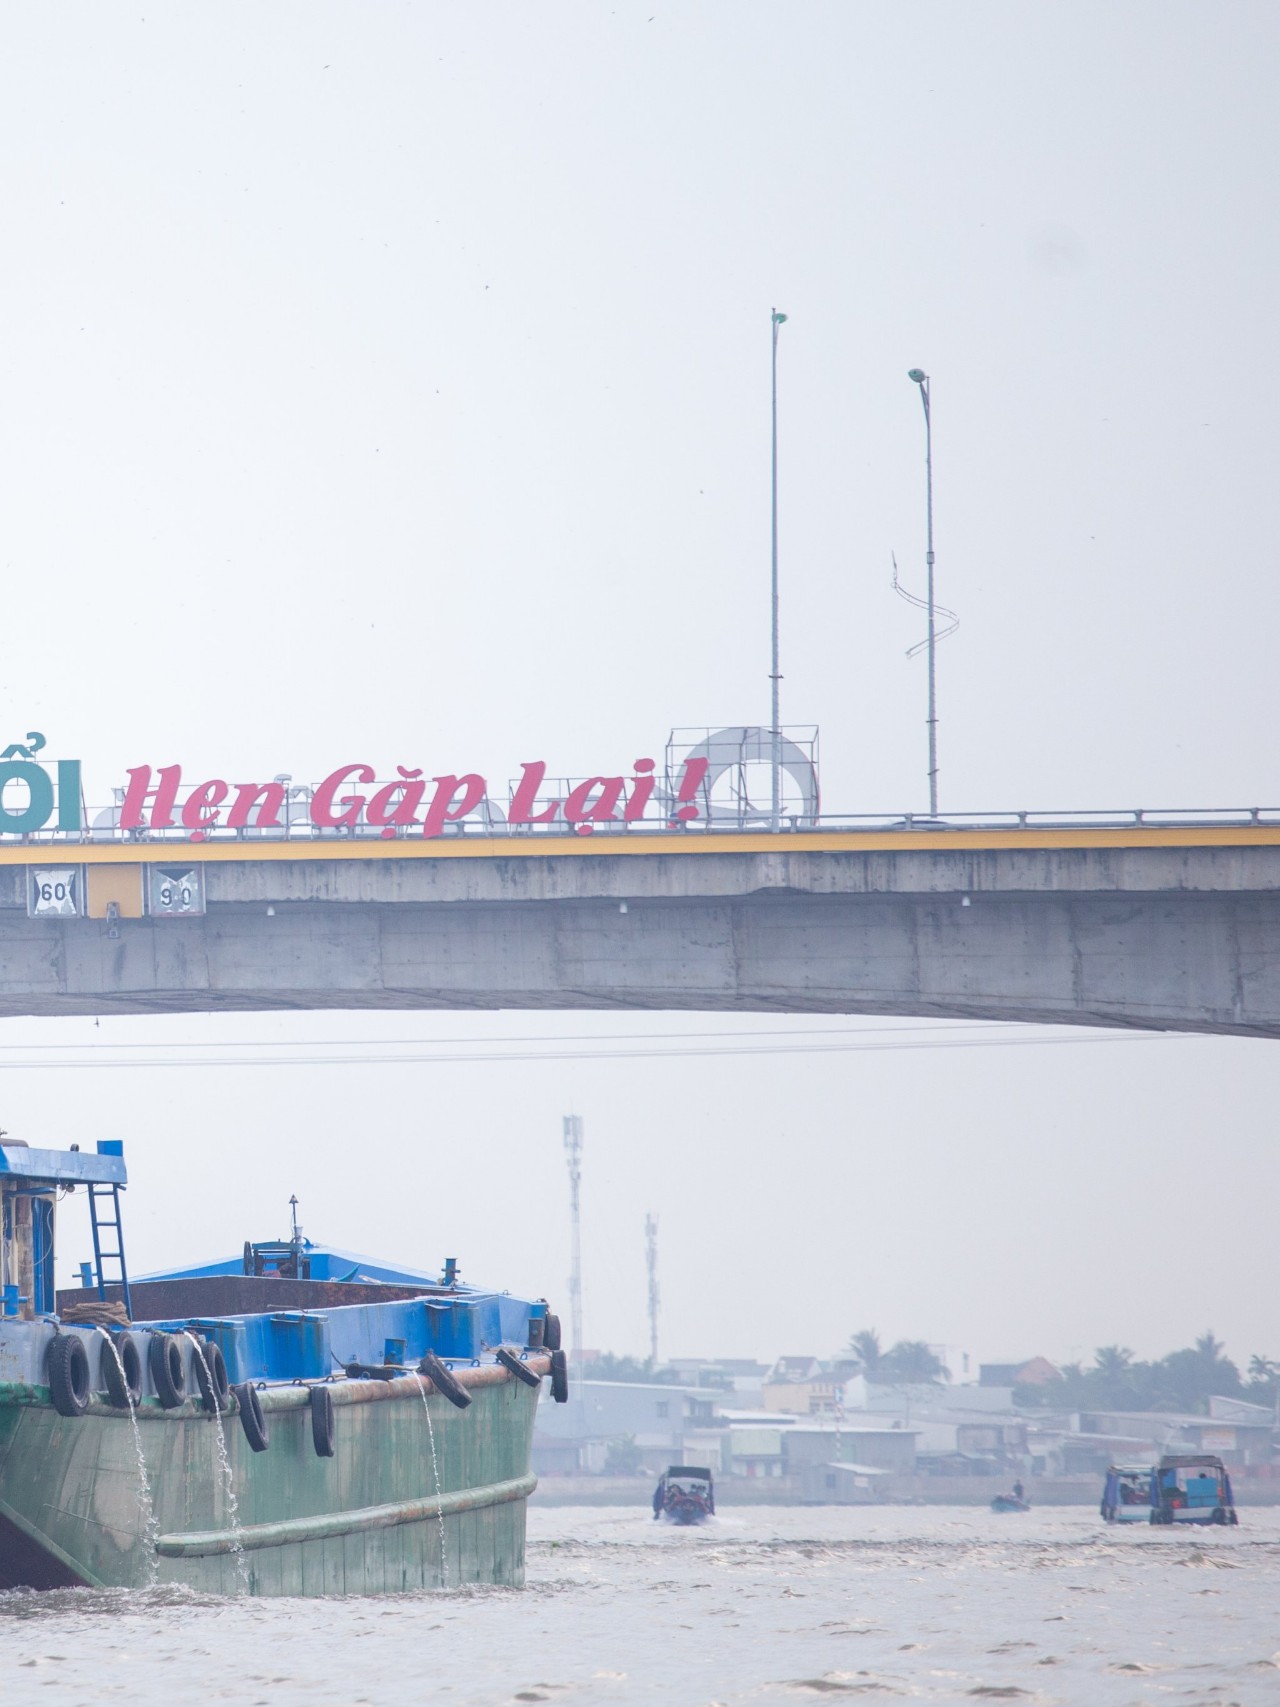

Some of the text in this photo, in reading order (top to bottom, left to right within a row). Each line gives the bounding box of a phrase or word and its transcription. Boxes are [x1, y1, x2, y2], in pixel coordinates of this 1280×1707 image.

[120, 764, 285, 843] Hẹn
[310, 764, 486, 840] Gặp
[41, 883, 66, 901] 60
